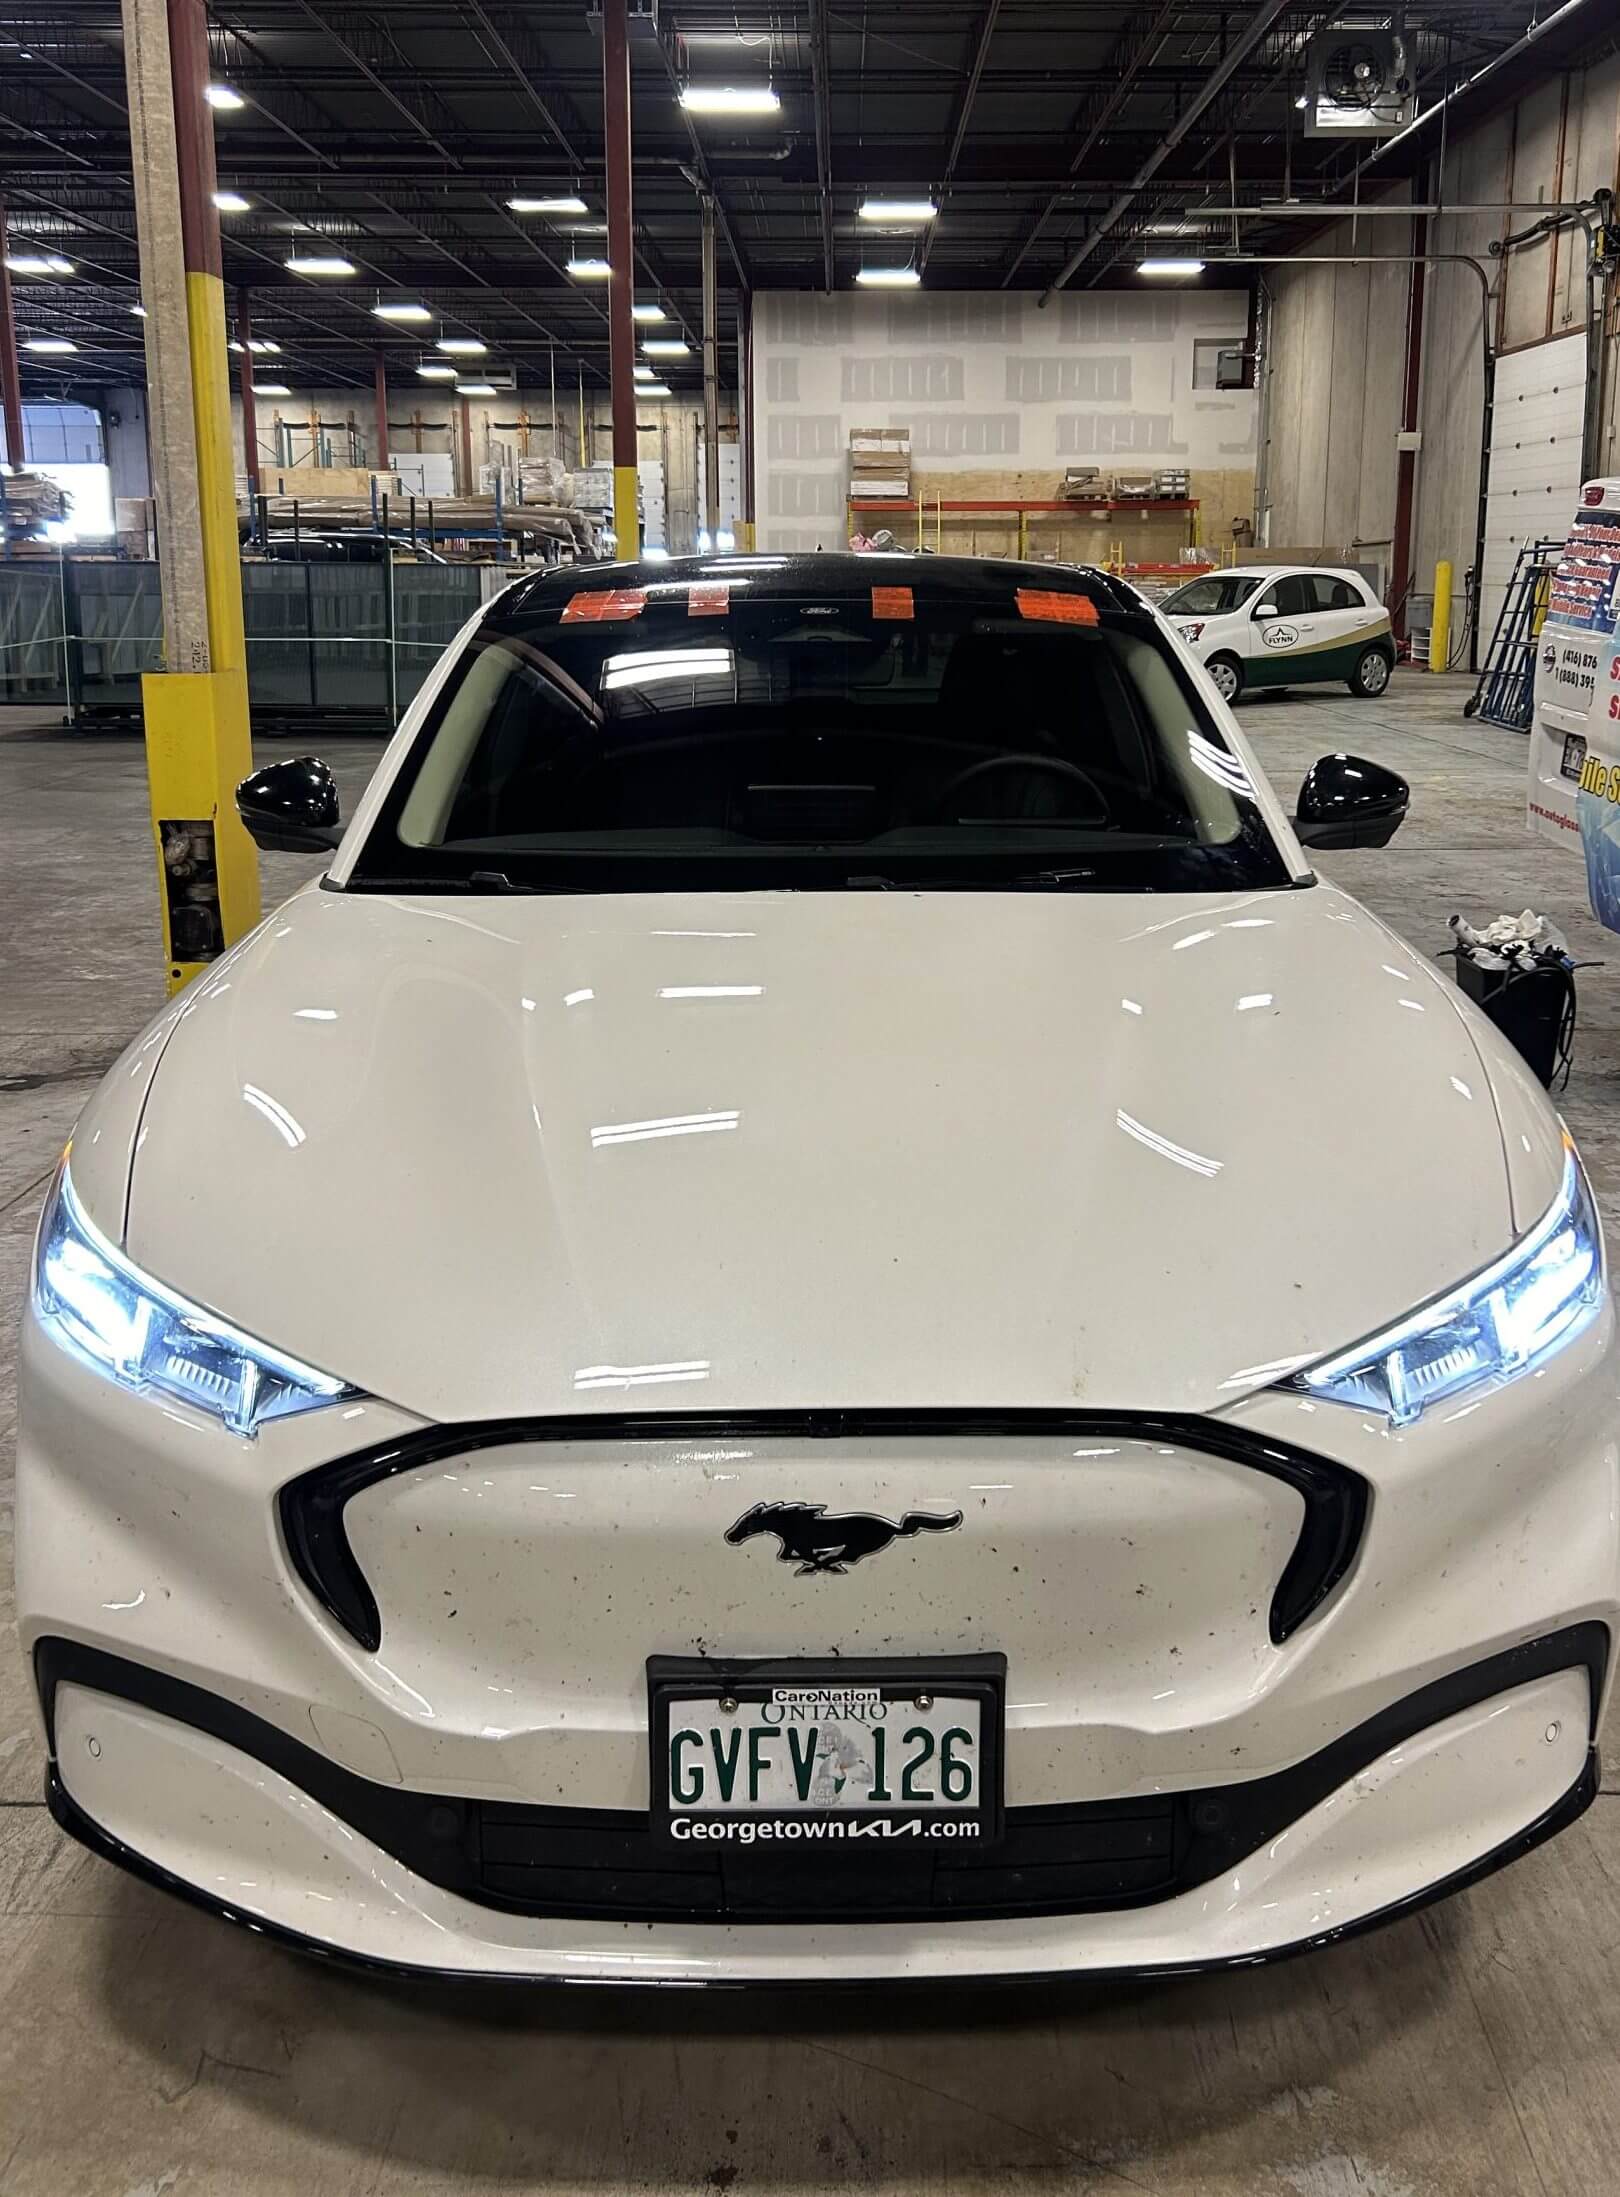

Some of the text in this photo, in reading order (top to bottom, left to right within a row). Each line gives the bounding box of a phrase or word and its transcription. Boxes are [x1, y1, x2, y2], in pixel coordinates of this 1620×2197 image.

[1268, 635, 1293, 644] FLYNN
[1562, 649, 1597, 669] (416) 876
[1560, 669, 1579, 688] (888)
[761, 1703, 888, 1726] ONTARIO
[670, 1727, 974, 1804] GVFV 126
